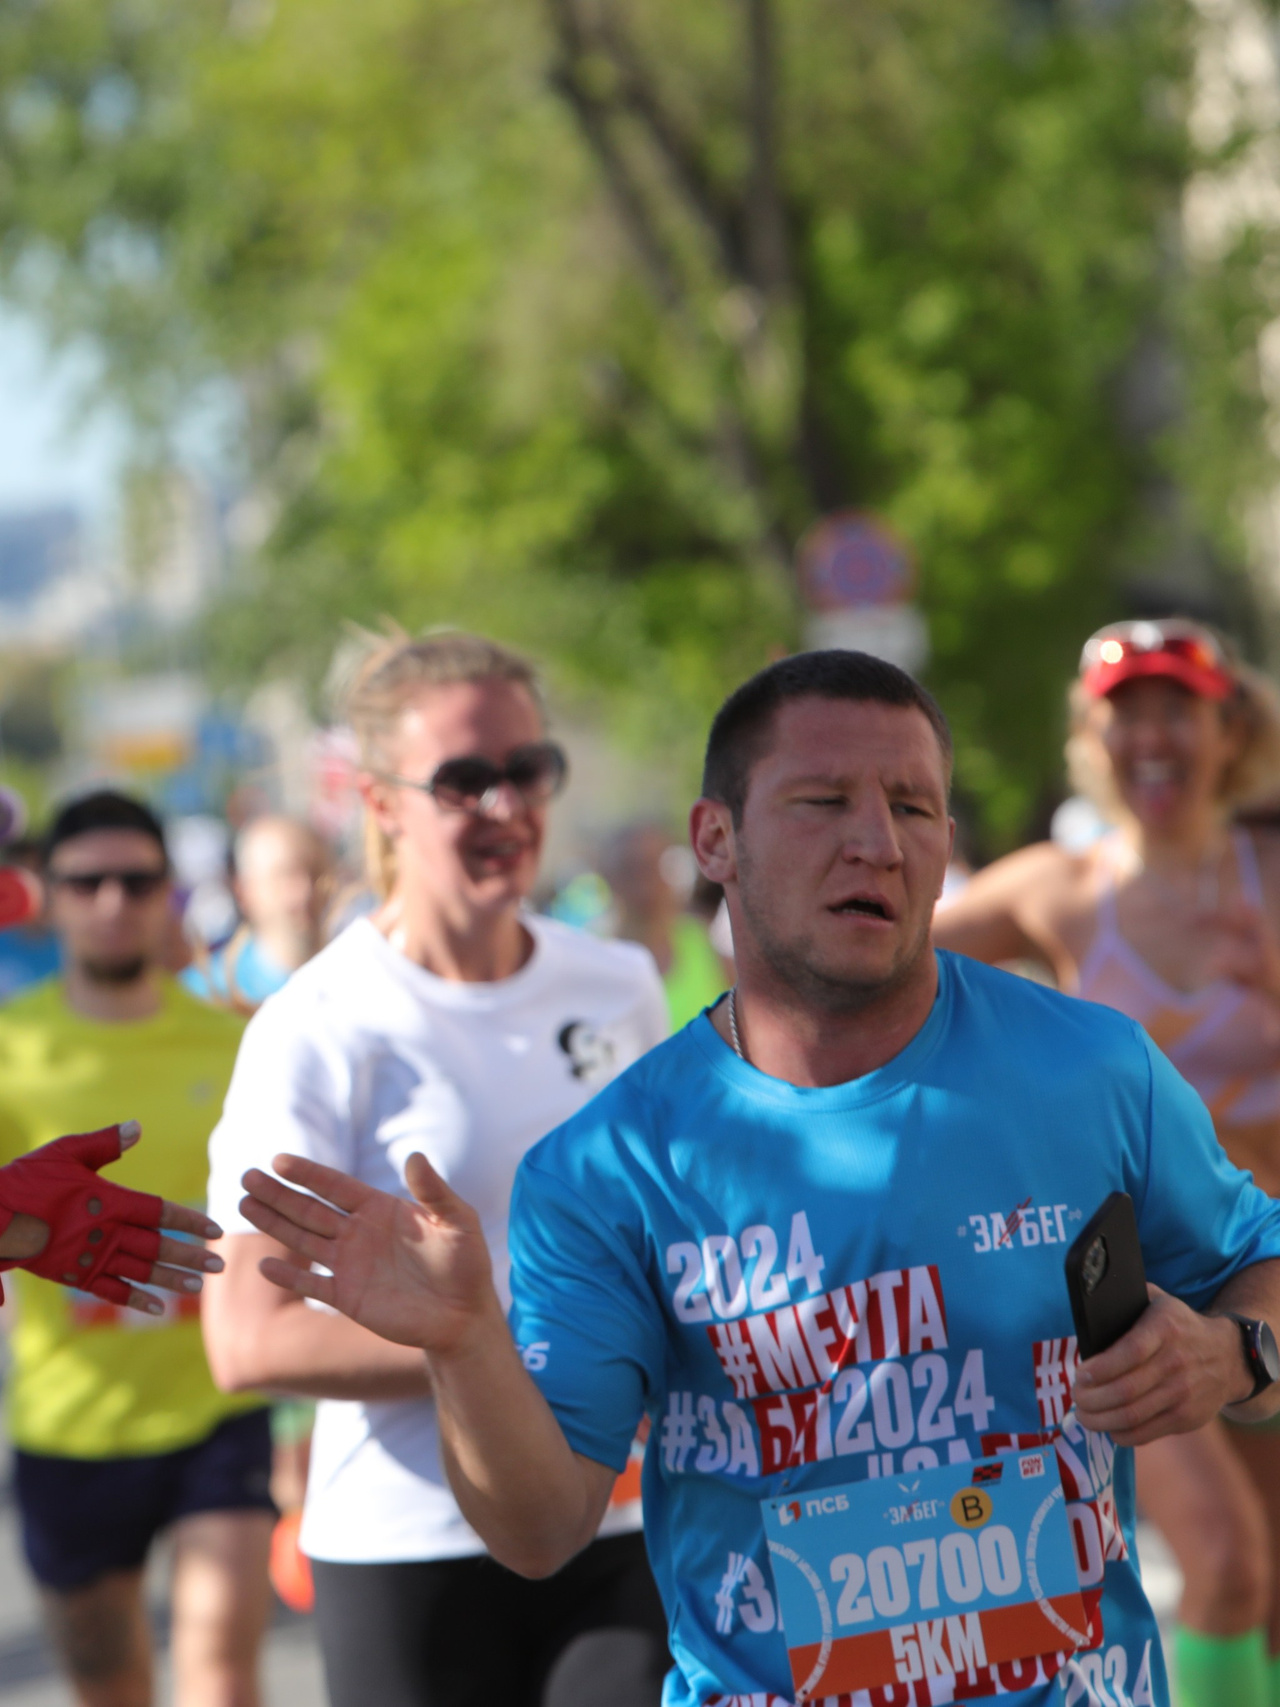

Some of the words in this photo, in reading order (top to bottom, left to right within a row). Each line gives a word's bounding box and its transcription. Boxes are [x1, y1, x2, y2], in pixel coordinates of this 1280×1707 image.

[666, 1211, 825, 1324] 2024
[805, 1494, 850, 1517] ПСБ
[829, 1525, 1022, 1626] 20700
